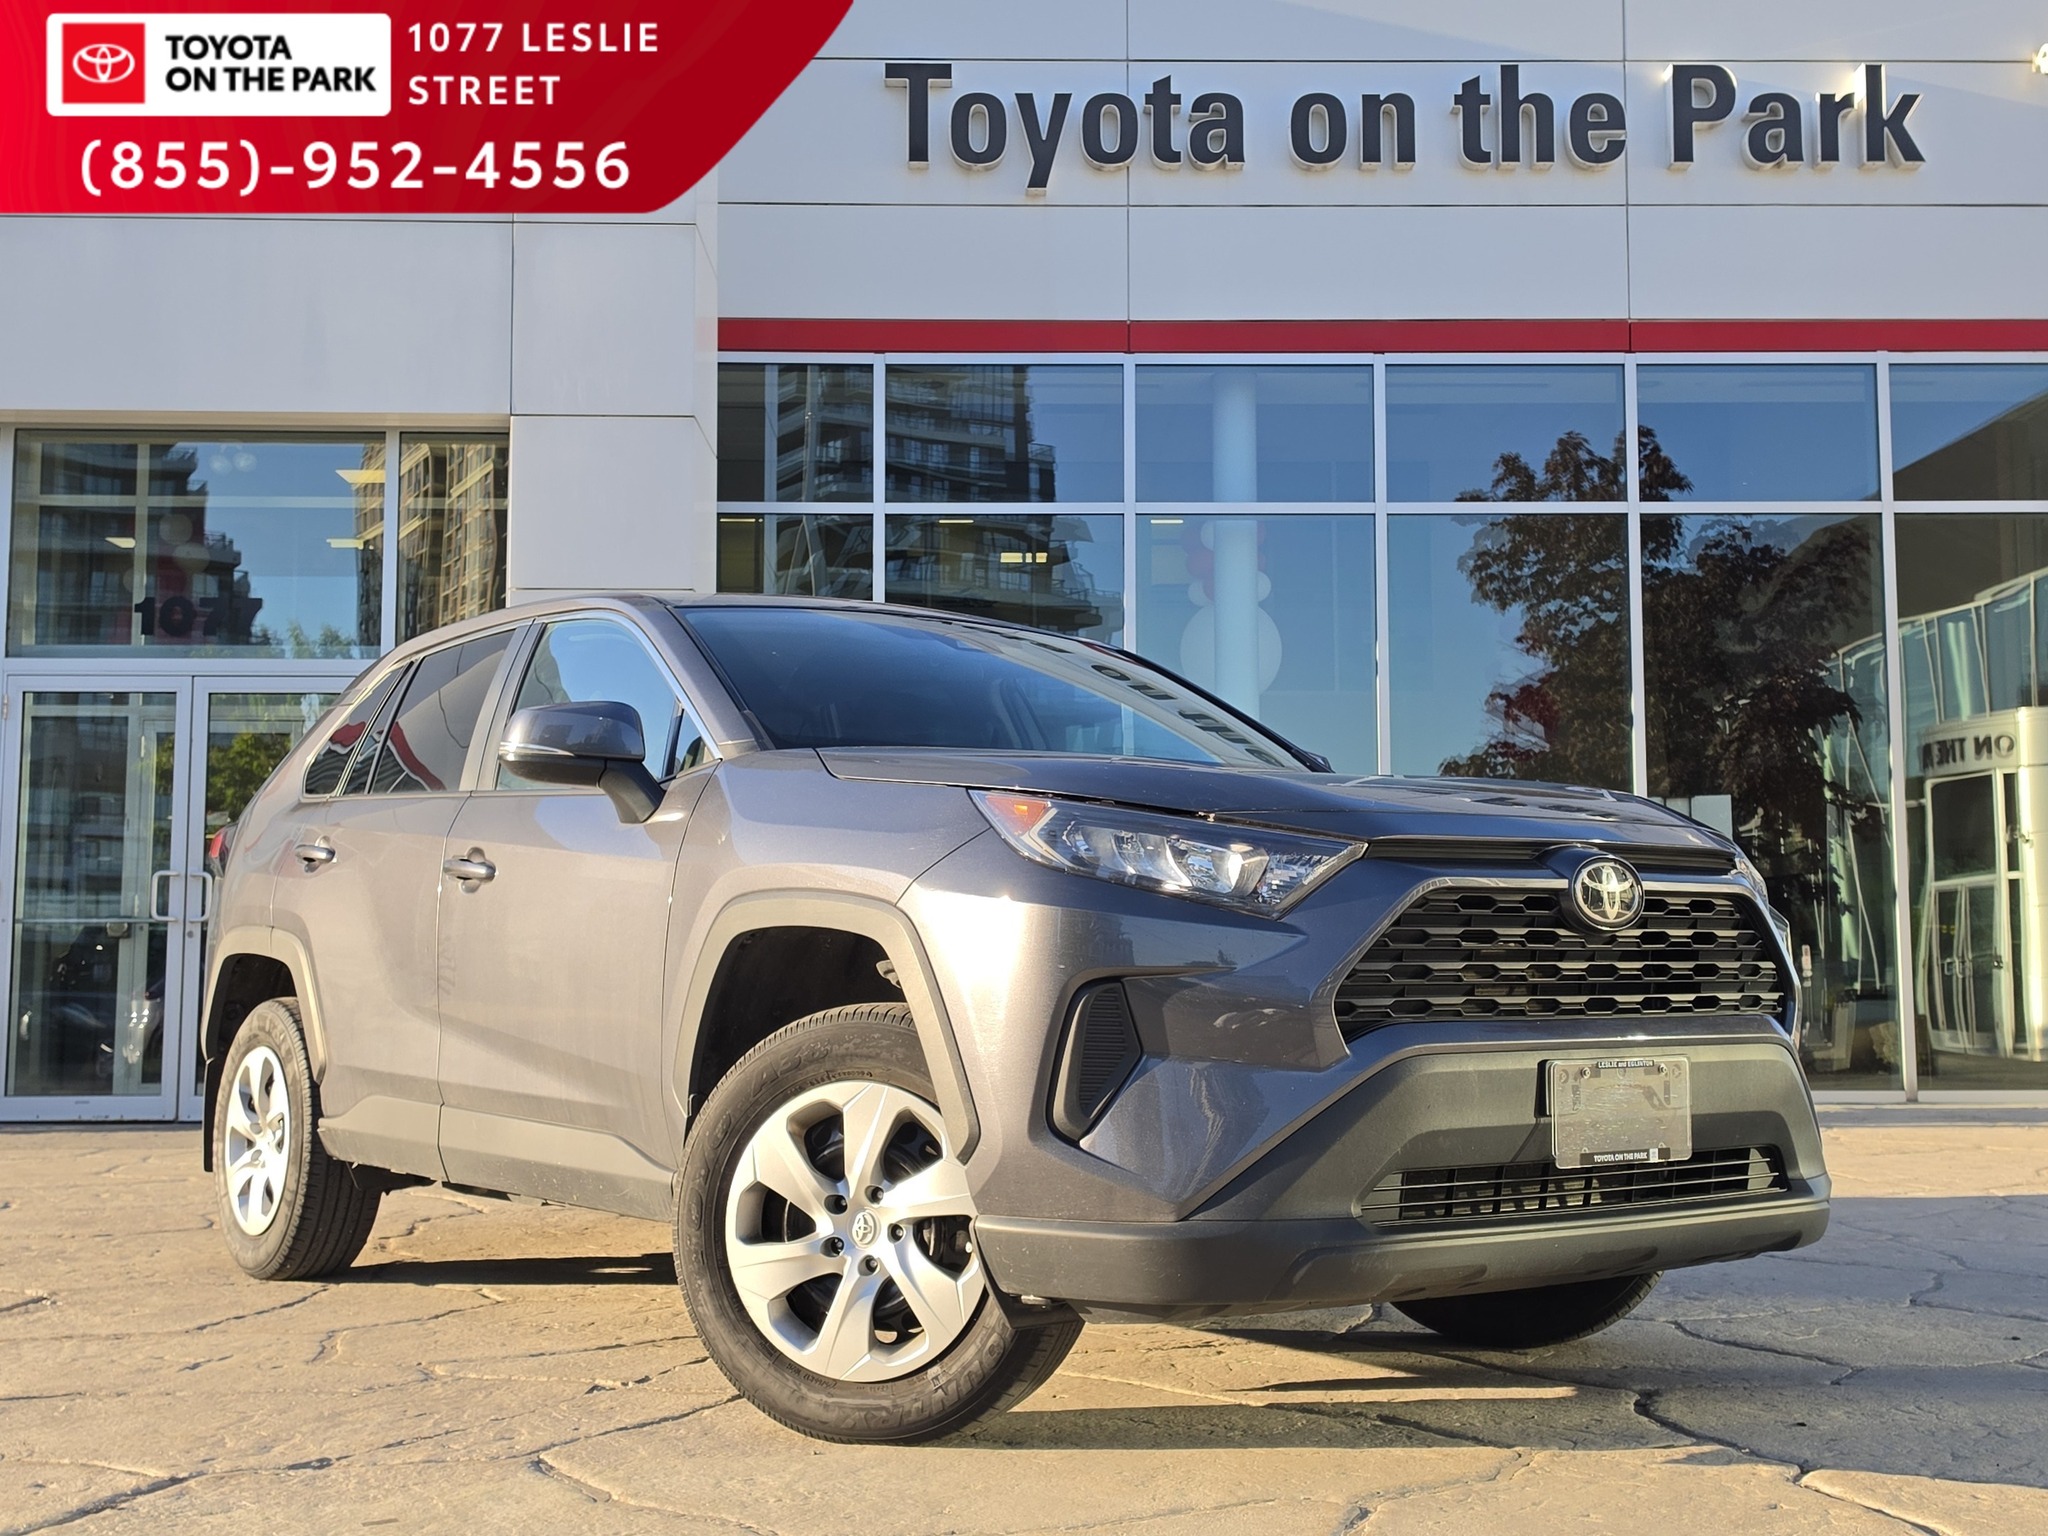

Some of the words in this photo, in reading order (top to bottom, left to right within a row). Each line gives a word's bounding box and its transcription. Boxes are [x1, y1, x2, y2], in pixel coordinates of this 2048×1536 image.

[884, 63, 1245, 195] Toyota
[1290, 92, 1416, 170] on
[1453, 64, 1627, 169] the
[1665, 64, 1926, 170] Park
[1593, 1154, 1614, 1163] TOYOTA
[1624, 1153, 1634, 1161] THE
[1634, 1151, 1648, 1160] PARK
